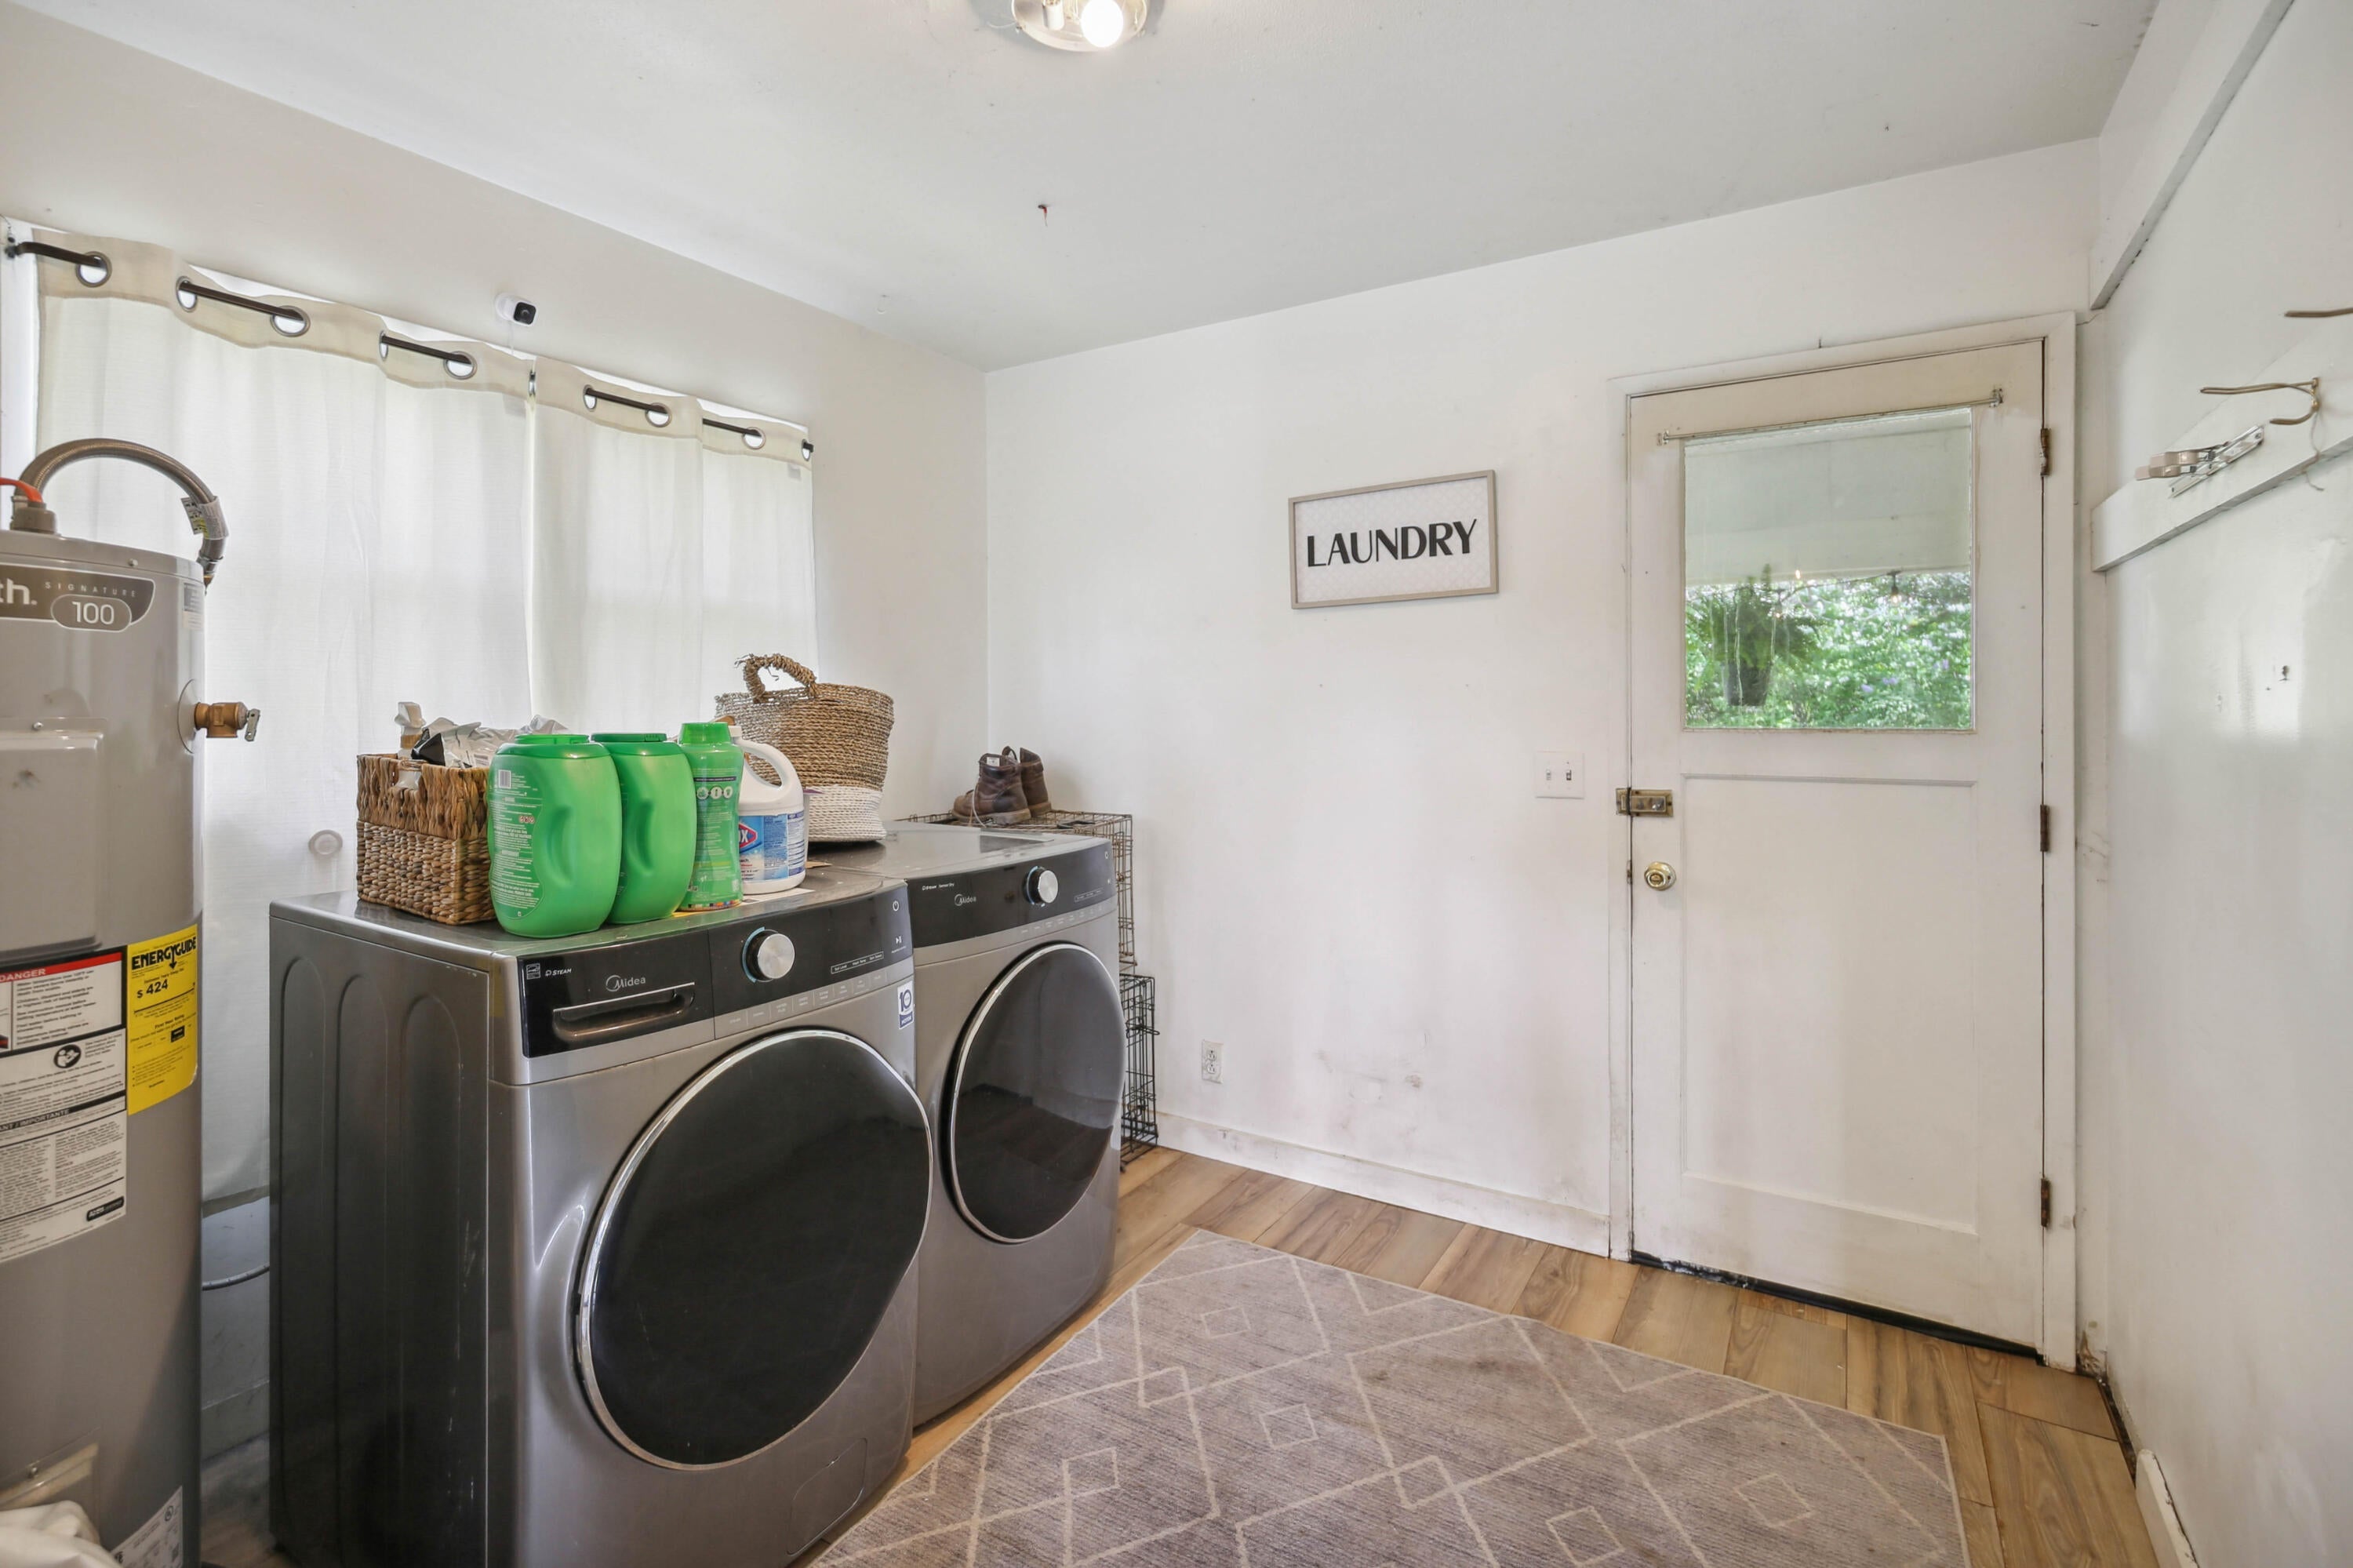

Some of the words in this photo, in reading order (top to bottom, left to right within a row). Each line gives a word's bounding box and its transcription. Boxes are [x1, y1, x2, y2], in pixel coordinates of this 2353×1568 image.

[1307, 518, 1477, 567] LAUNDRY
[45, 581, 136, 598] SIGNATURE
[71, 601, 115, 625] 100
[955, 893, 976, 906] Midea
[132, 936, 196, 970] ENERGYGUIDE
[0, 968, 46, 981] DANGER
[606, 975, 646, 991] Midea
[146, 979, 169, 994] 424
[900, 989, 912, 1012] 10
